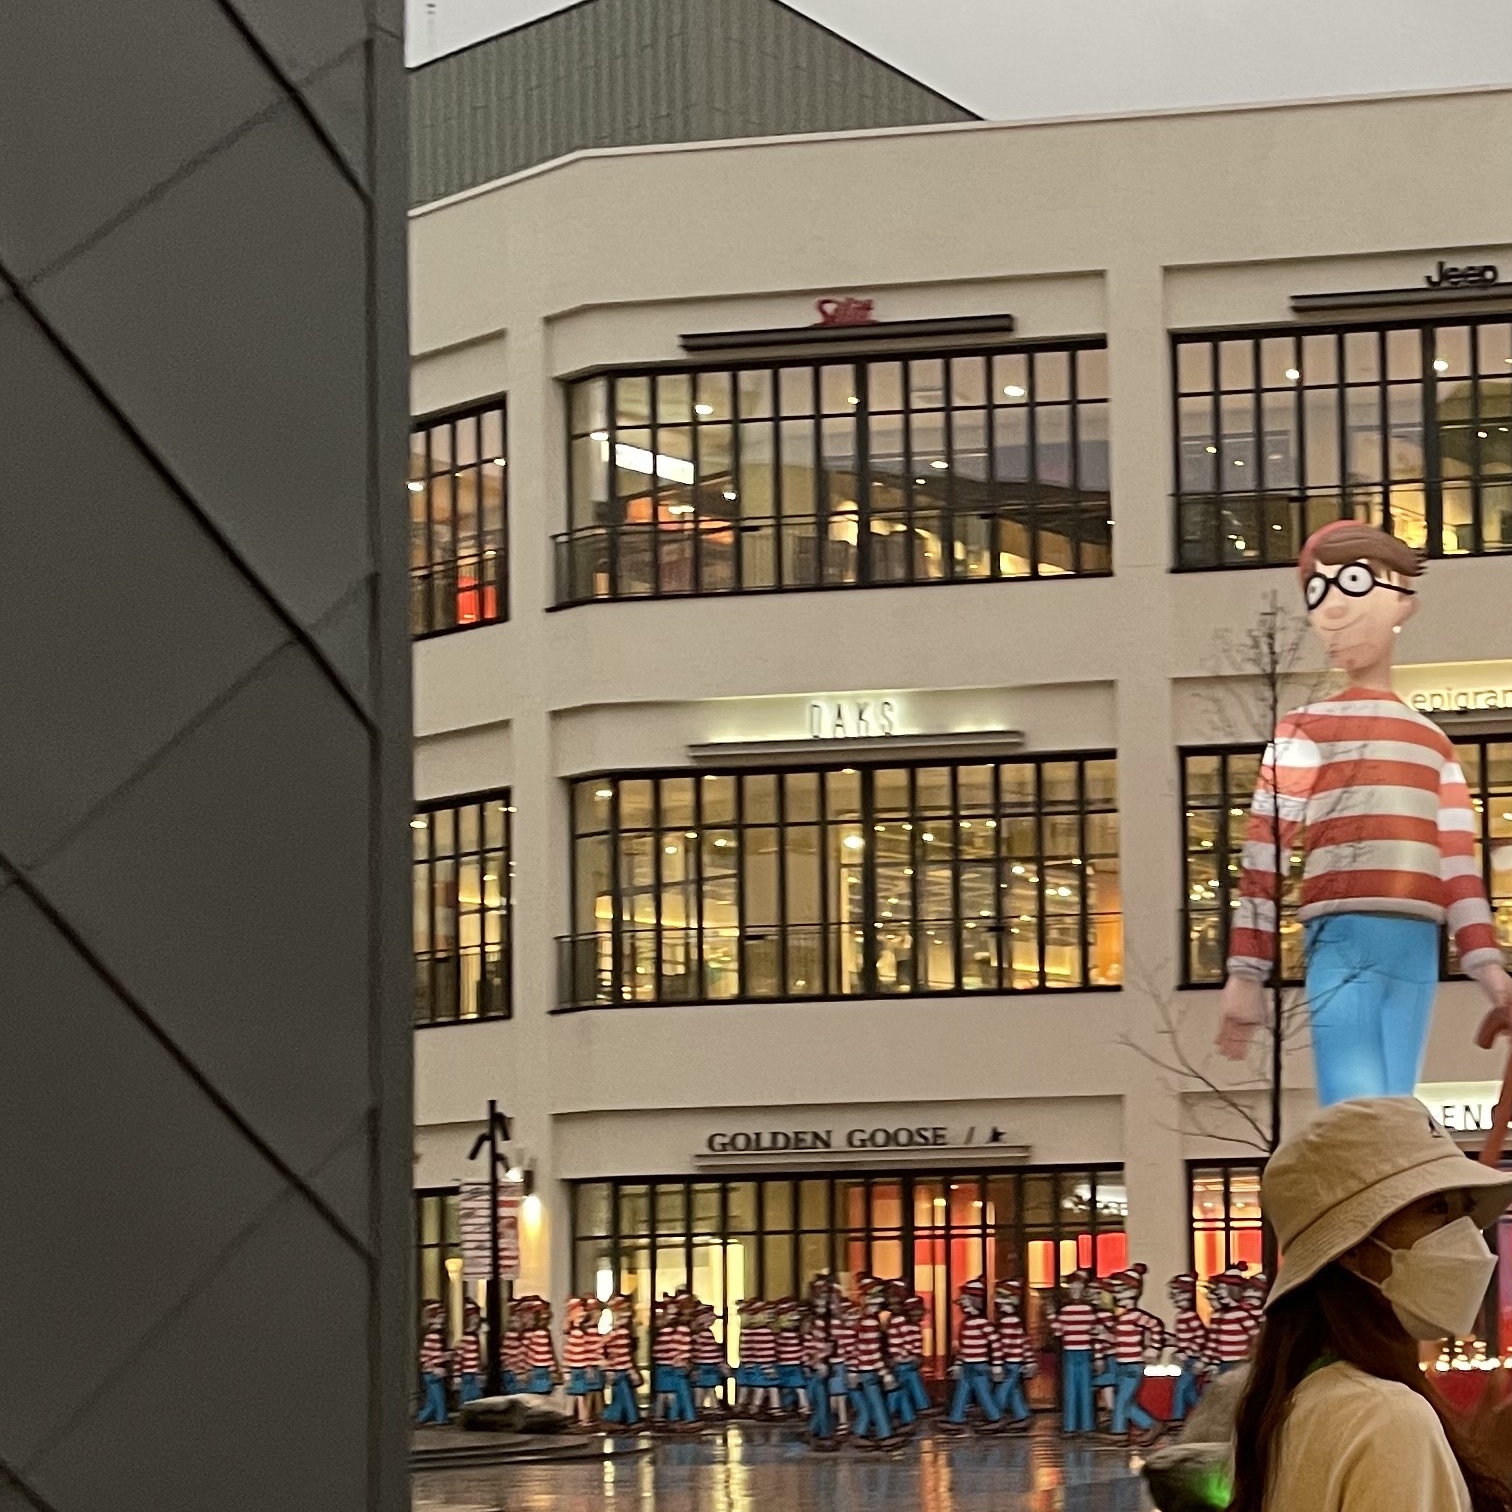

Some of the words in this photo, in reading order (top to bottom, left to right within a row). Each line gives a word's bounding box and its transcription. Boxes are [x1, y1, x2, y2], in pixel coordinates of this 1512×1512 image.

[1424, 260, 1499, 287] Jeep
[808, 701, 895, 739] DAKS
[706, 1129, 834, 1152] GOLDEN
[846, 1126, 948, 1149] GOOSE
